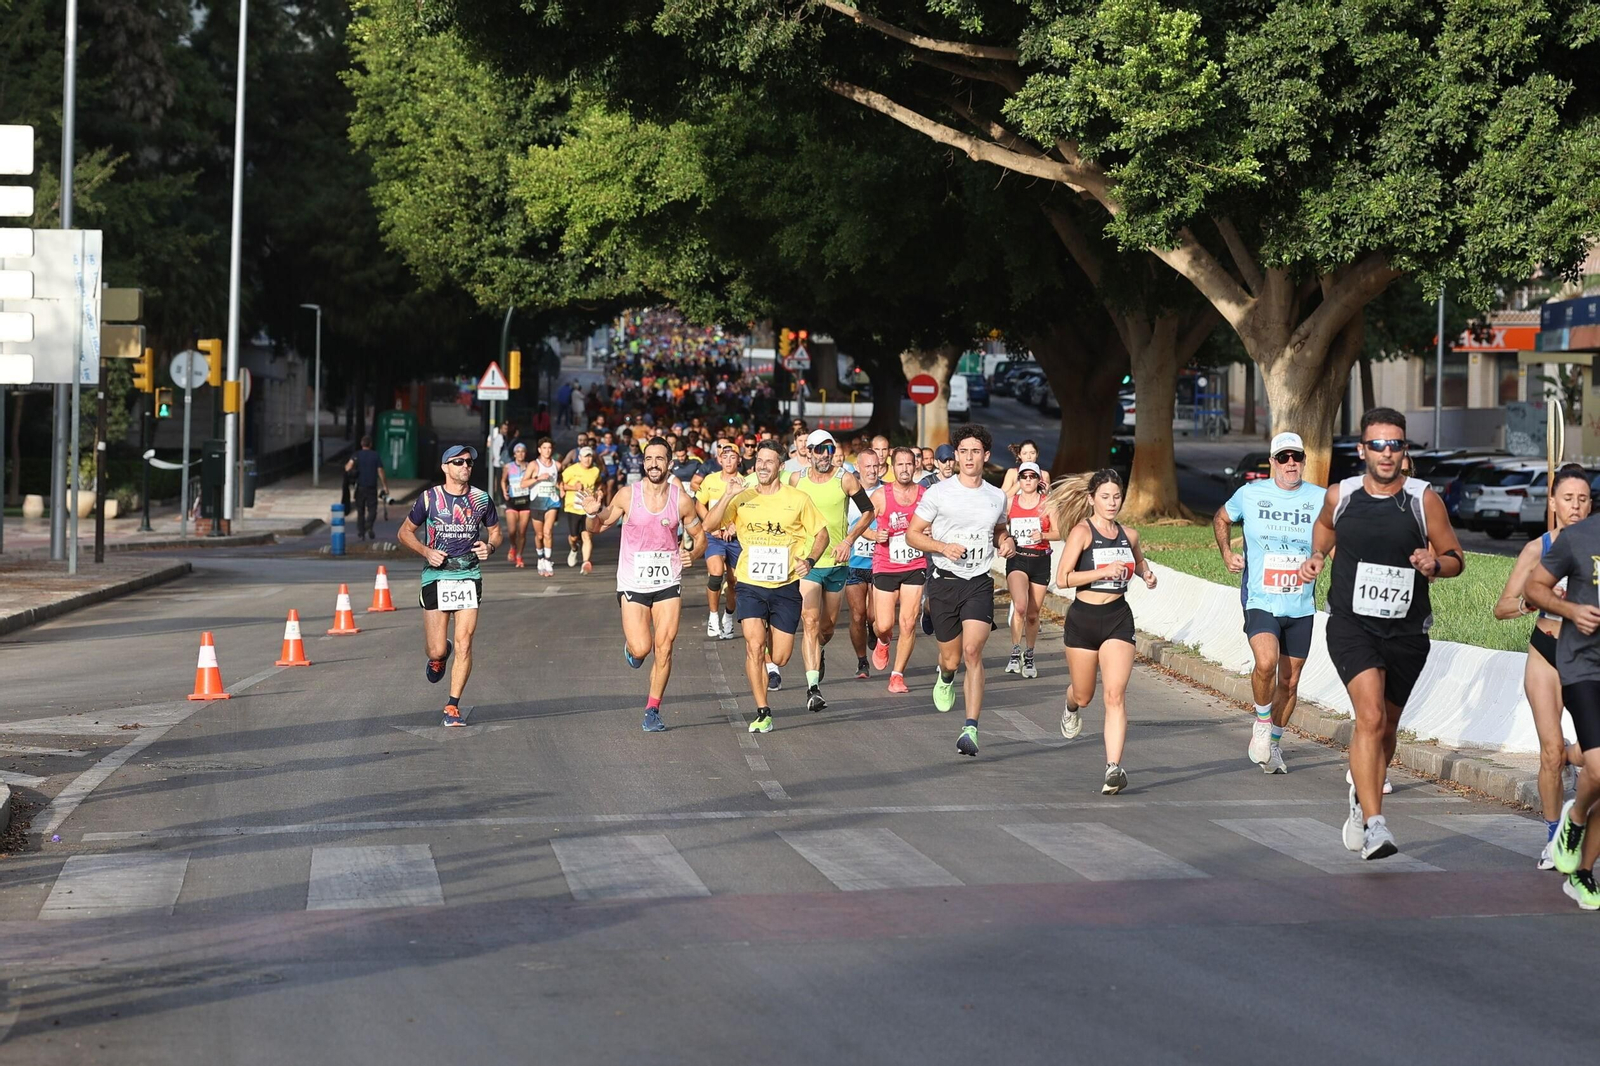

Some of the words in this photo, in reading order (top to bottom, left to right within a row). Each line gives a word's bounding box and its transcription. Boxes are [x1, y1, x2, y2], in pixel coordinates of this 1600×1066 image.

[1258, 509, 1311, 525] nerja
[445, 524, 464, 532] CROSS
[1265, 524, 1305, 533] ATLETISMO
[894, 548, 920, 559] 1185
[638, 565, 669, 578] 7970
[752, 562, 783, 574] 2771
[1271, 573, 1298, 587] 100
[442, 590, 472, 603] 5541
[1359, 584, 1410, 604] 10474
